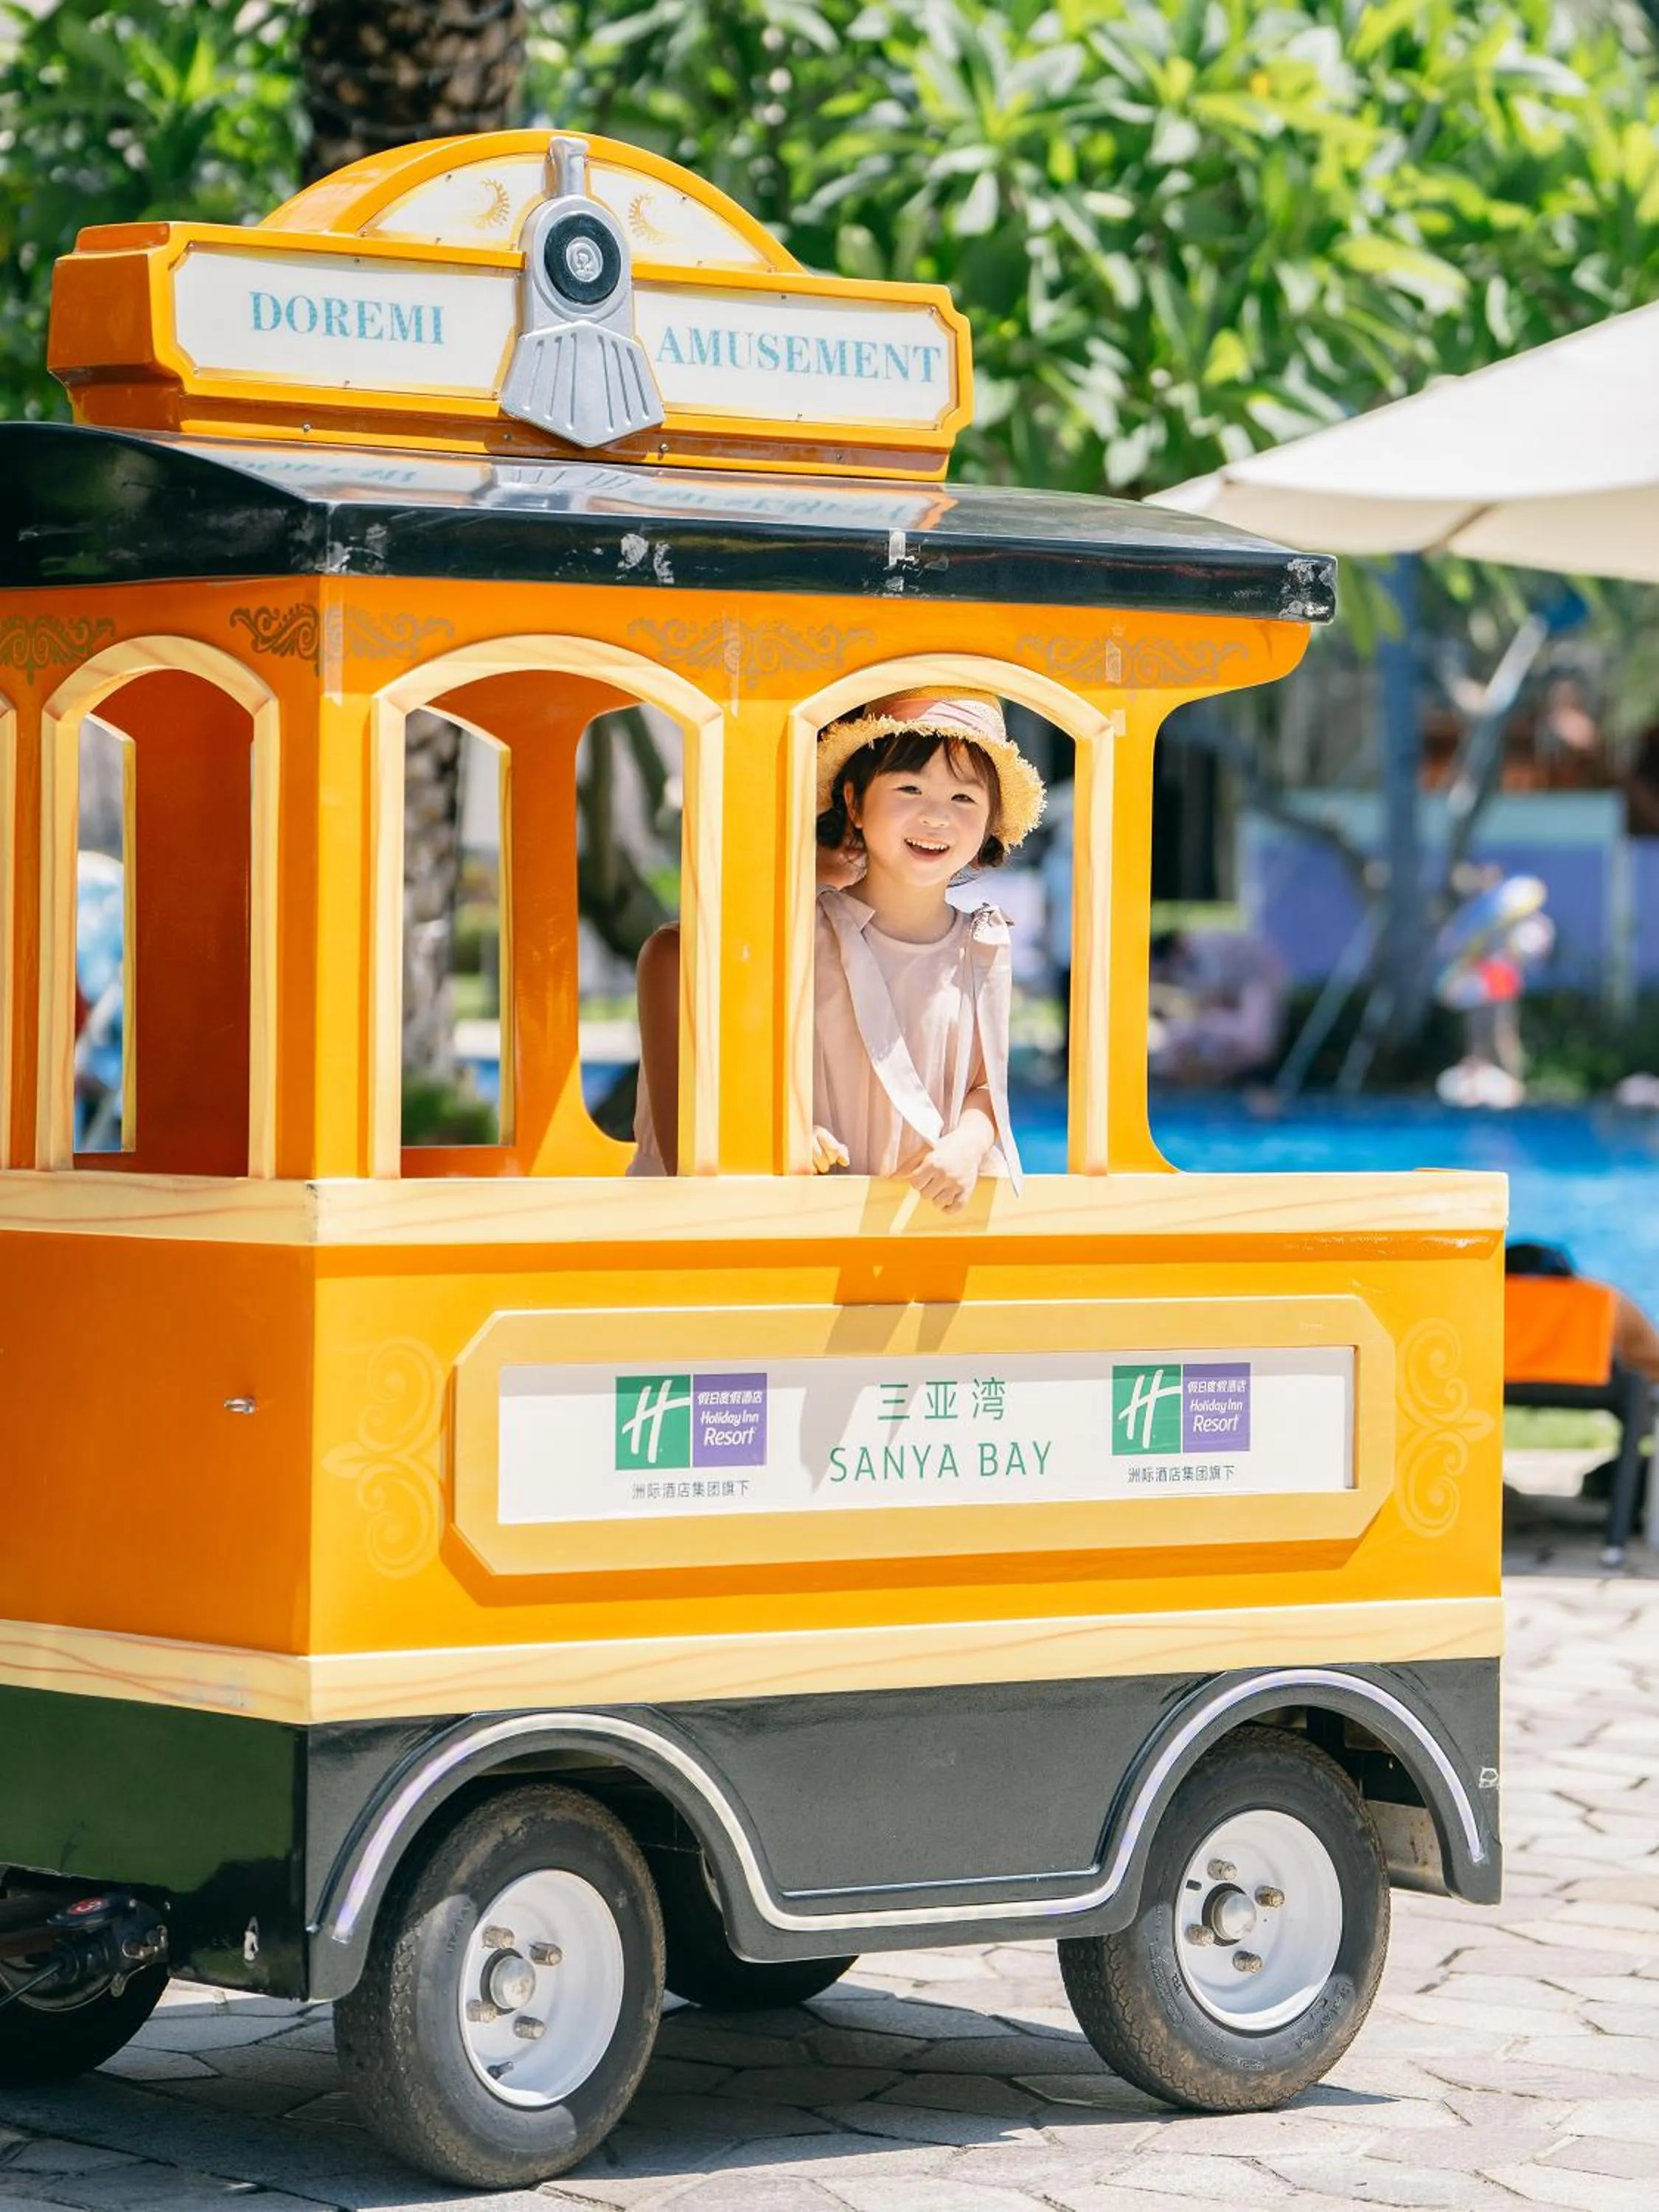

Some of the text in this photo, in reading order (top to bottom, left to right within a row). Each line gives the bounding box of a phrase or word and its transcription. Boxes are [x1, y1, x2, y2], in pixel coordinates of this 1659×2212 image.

[250, 291, 444, 346] DOREMI
[656, 326, 942, 383] AMUSEMENT
[877, 1377, 1006, 1420] 三亚湾
[1190, 1397, 1243, 1413] Holiday Inn
[700, 1409, 759, 1427] Holiday Inn
[1193, 1413, 1239, 1433] Resort
[704, 1427, 755, 1446] Resort
[830, 1440, 1052, 1483] SANYA BAY
[1127, 1464, 1235, 1484] 洲际酒店集团旗下
[632, 1479, 751, 1500] 洲际酒店集团旗下
